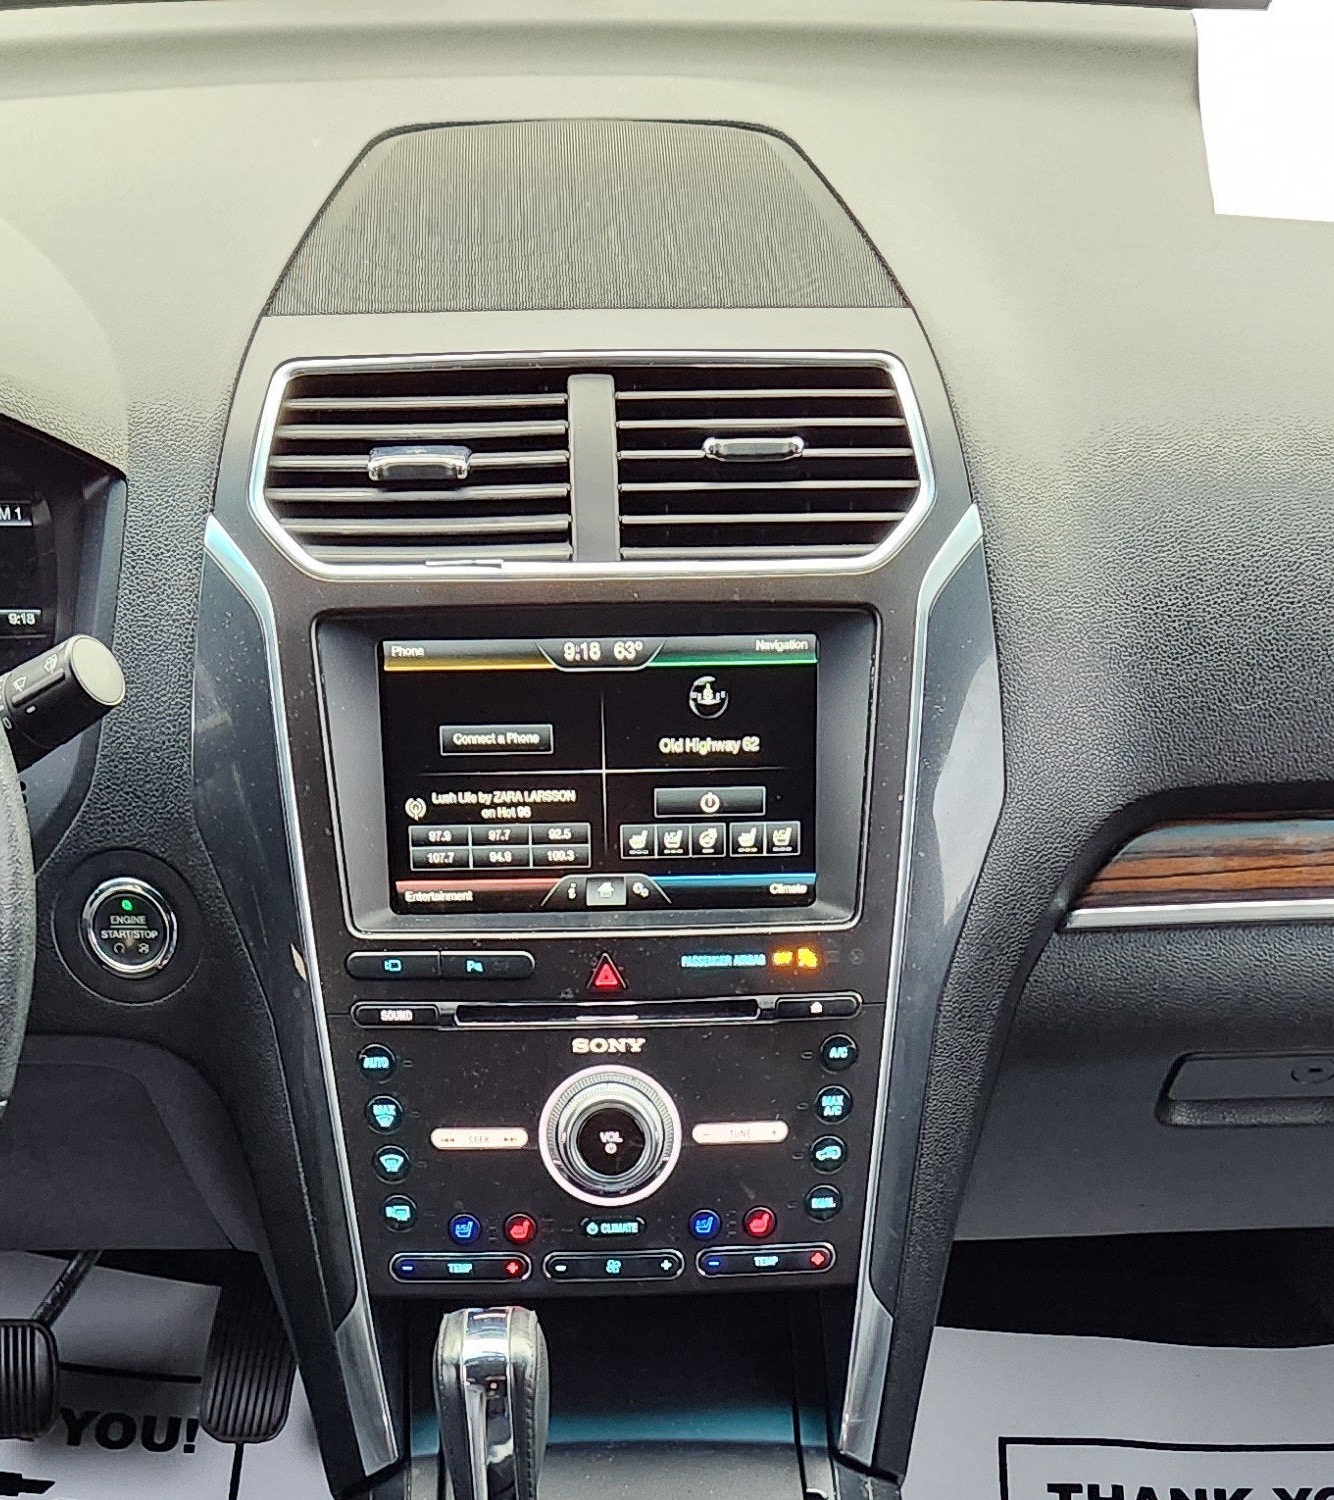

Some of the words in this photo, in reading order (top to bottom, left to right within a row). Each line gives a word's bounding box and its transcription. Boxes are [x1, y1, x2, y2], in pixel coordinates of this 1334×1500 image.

[14, 507, 22, 521] 1
[391, 645, 425, 658] Phone
[563, 641, 602, 662] 9:18
[755, 639, 809, 652] Navigation
[452, 732, 496, 745] Connect
[506, 732, 540, 745] Phone
[658, 737, 684, 754] Old
[685, 737, 741, 755] Highway
[742, 735, 760, 752] 62
[478, 790, 493, 806] by
[493, 790, 523, 804] ZARA
[523, 789, 577, 804] LARSSON
[404, 890, 474, 903] Entertainment
[109, 915, 147, 925] ENGINE
[380, 1009, 414, 1022] SOUND
[572, 1037, 647, 1054] SONY
[828, 1046, 848, 1059] A/C
[362, 1056, 390, 1069] AUTO
[467, 1135, 490, 1145] SEEK
[729, 1128, 752, 1139] TUNE
[600, 1222, 639, 1234] CLIMATE
[60, 1407, 200, 1454] YOU!
